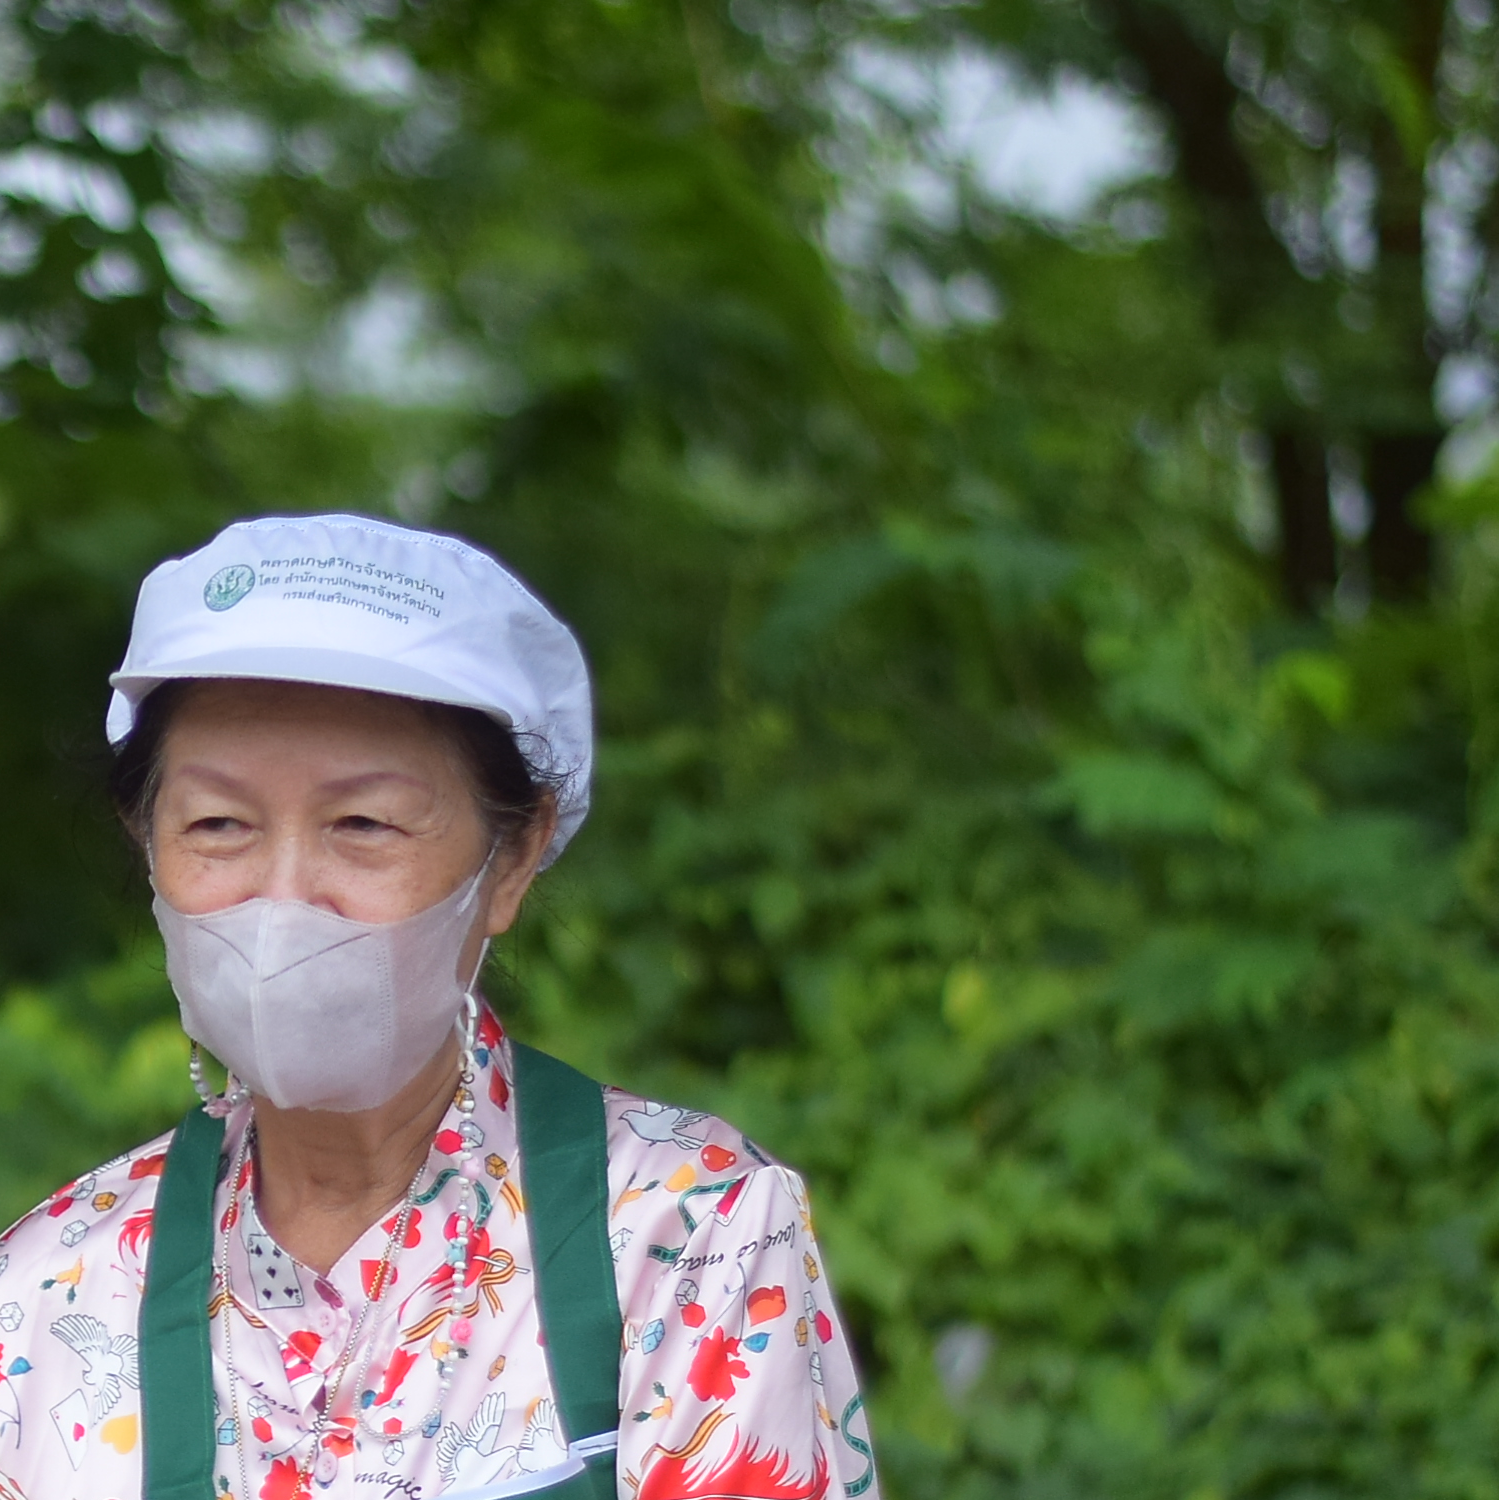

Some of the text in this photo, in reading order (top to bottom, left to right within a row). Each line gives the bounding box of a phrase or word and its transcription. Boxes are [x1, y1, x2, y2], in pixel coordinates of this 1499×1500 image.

[258, 574, 280, 587] โดย
[260, 556, 445, 601] ตลาดเกษตรกรจังหวัดน่าน
[282, 590, 410, 625] กรมส่งเสริมการเกษตร
[354, 1470, 423, 1500] magic
